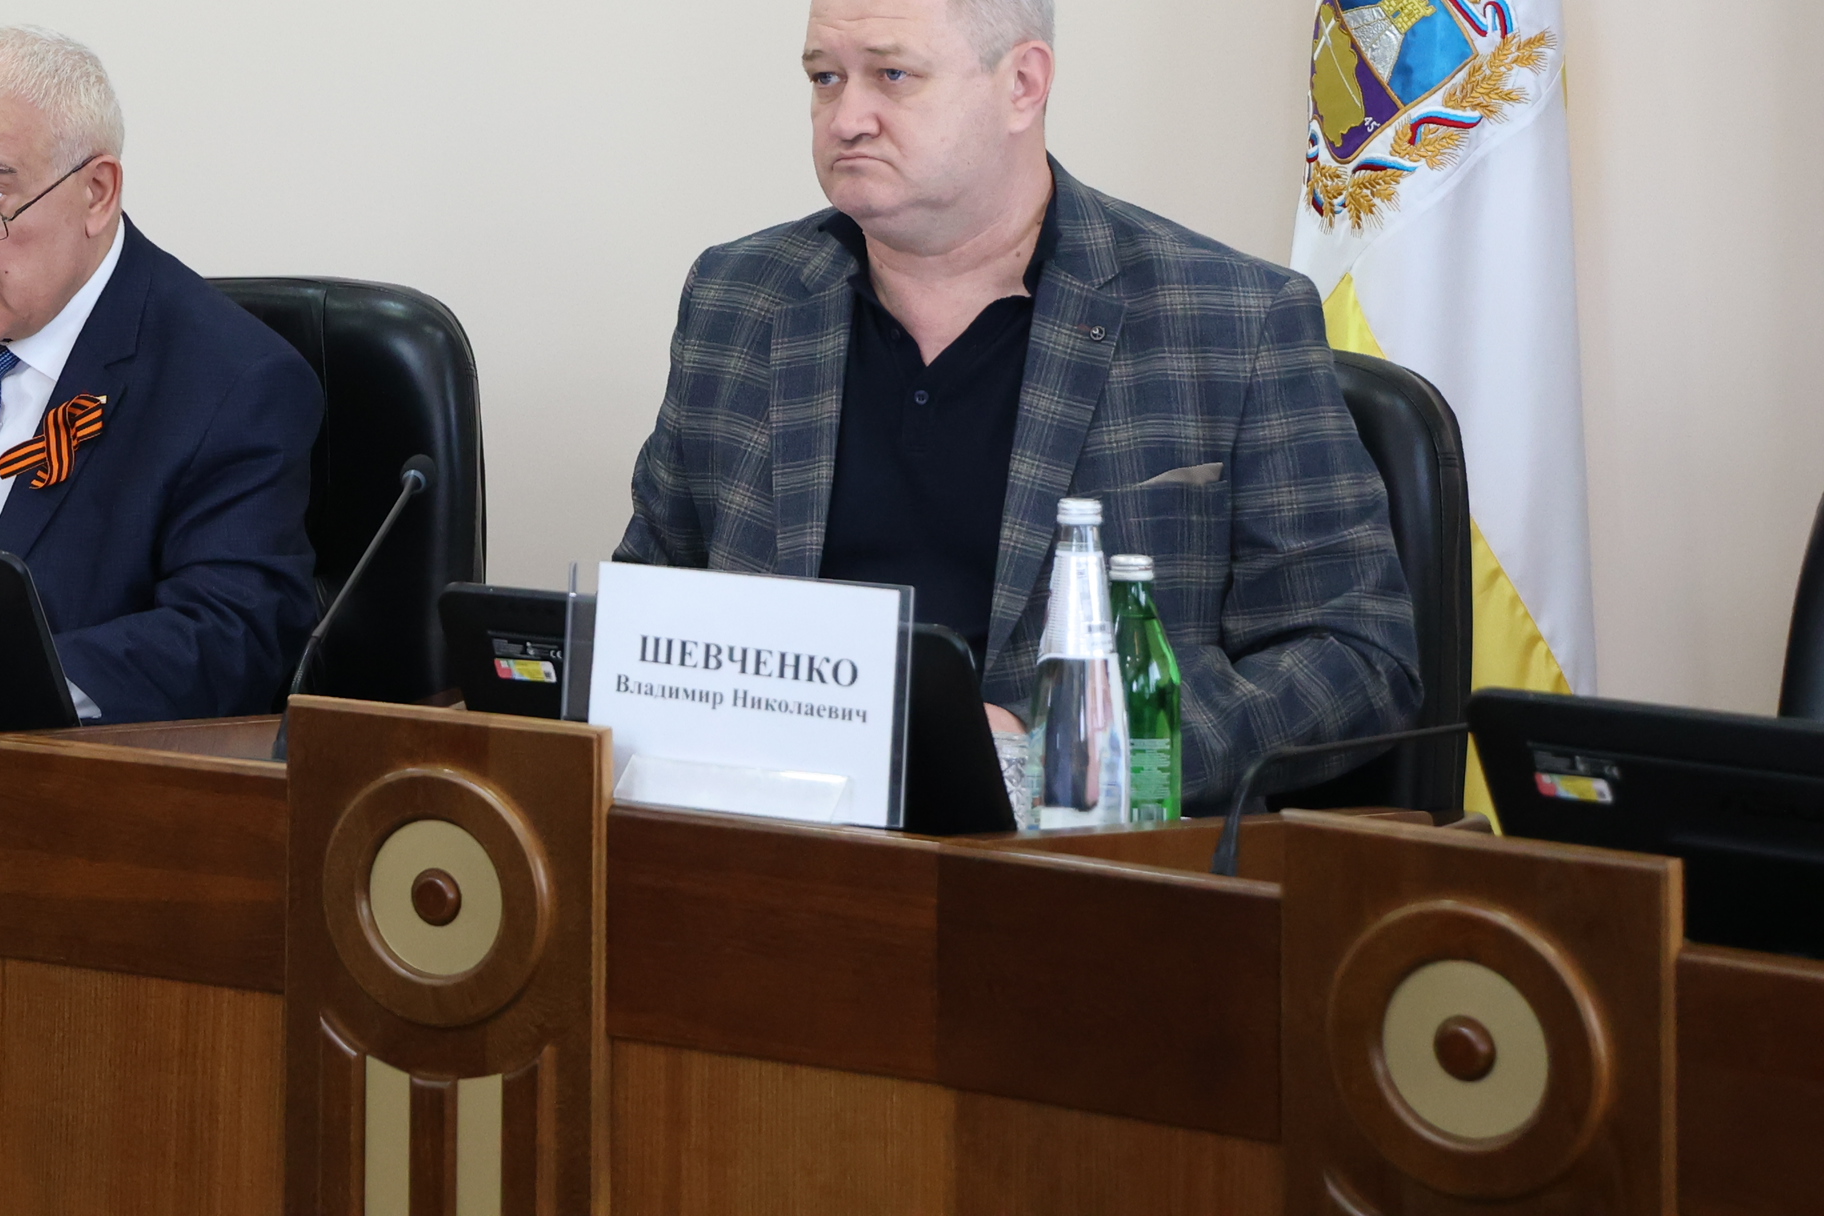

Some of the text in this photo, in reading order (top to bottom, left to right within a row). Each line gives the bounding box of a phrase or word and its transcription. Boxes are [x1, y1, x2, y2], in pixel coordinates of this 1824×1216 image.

[638, 633, 859, 688] ШЕВЧЕНКО
[615, 672, 869, 724] Владимир Николаевич
